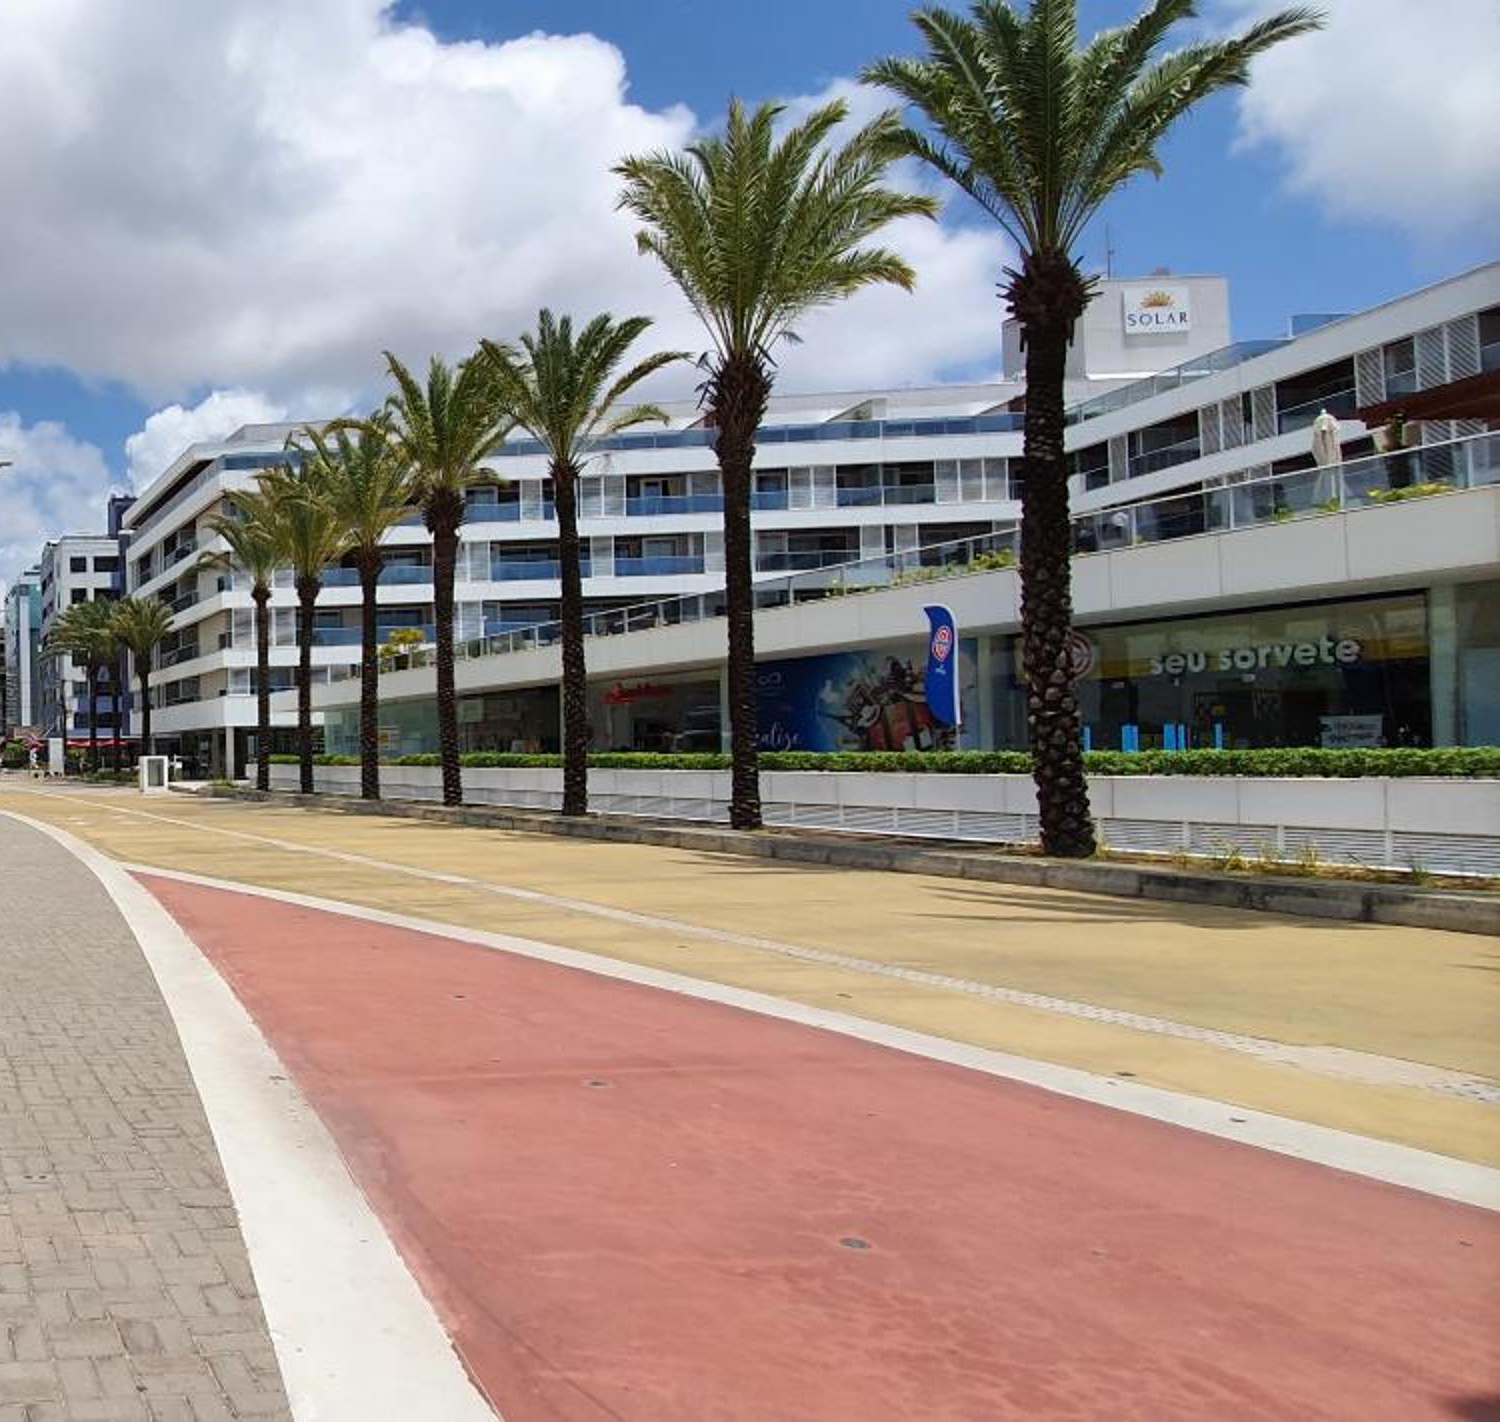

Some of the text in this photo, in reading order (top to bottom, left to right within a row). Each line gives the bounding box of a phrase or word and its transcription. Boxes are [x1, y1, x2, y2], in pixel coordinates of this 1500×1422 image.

[1127, 312, 1188, 327] SOLAR
[1151, 636, 1358, 675] seu sorvete
